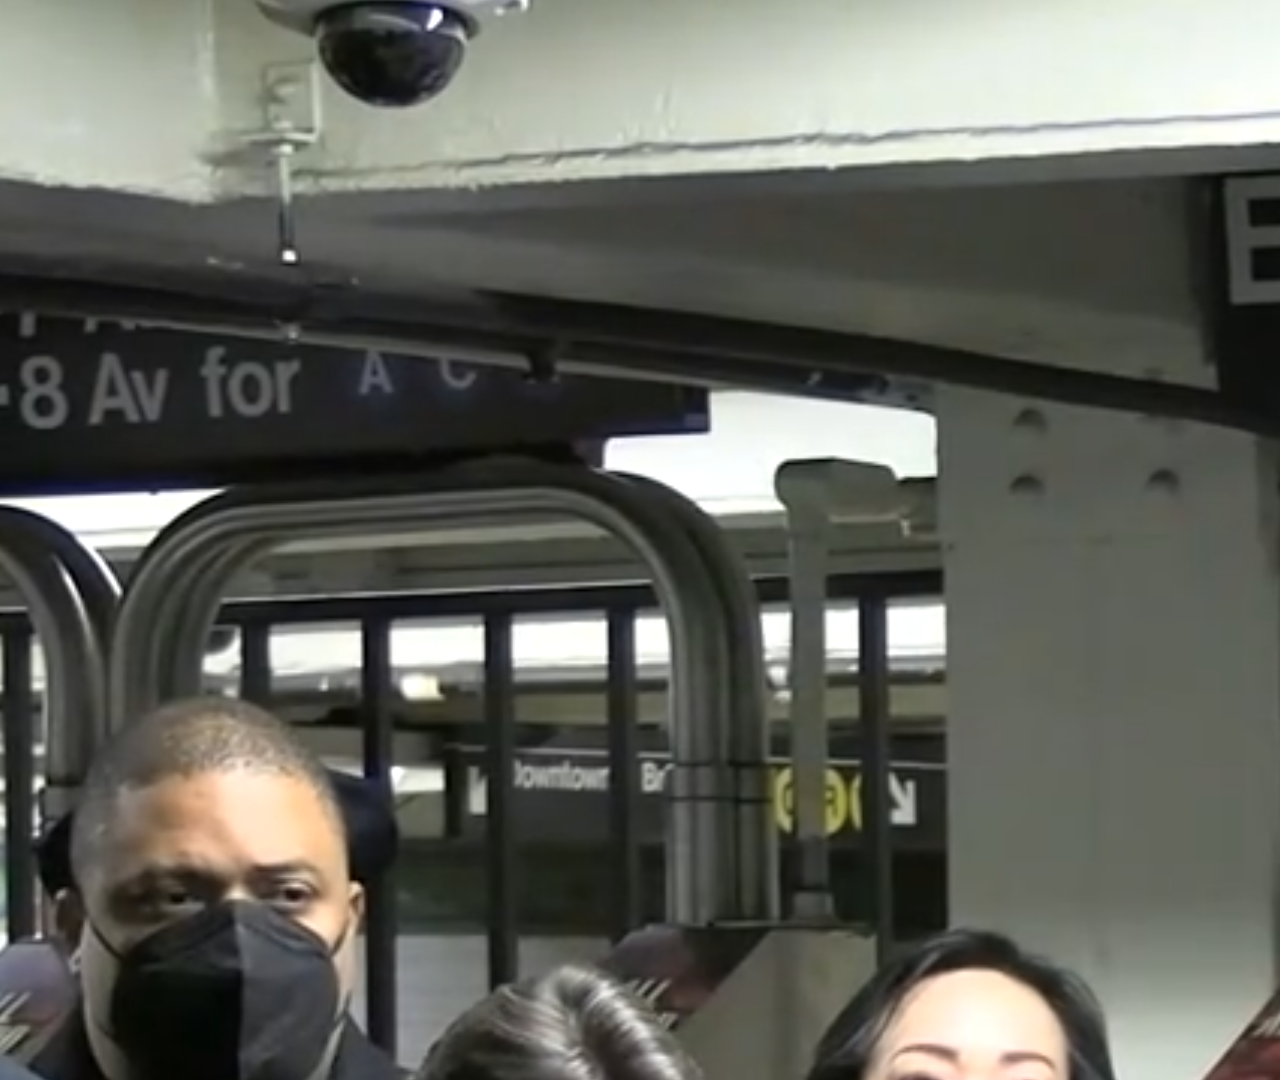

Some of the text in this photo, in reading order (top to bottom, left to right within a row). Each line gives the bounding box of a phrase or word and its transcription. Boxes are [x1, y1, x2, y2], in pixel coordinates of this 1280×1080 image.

[87, 351, 169, 426] Av
[200, 346, 300, 418] for
[357, 350, 394, 395] A
